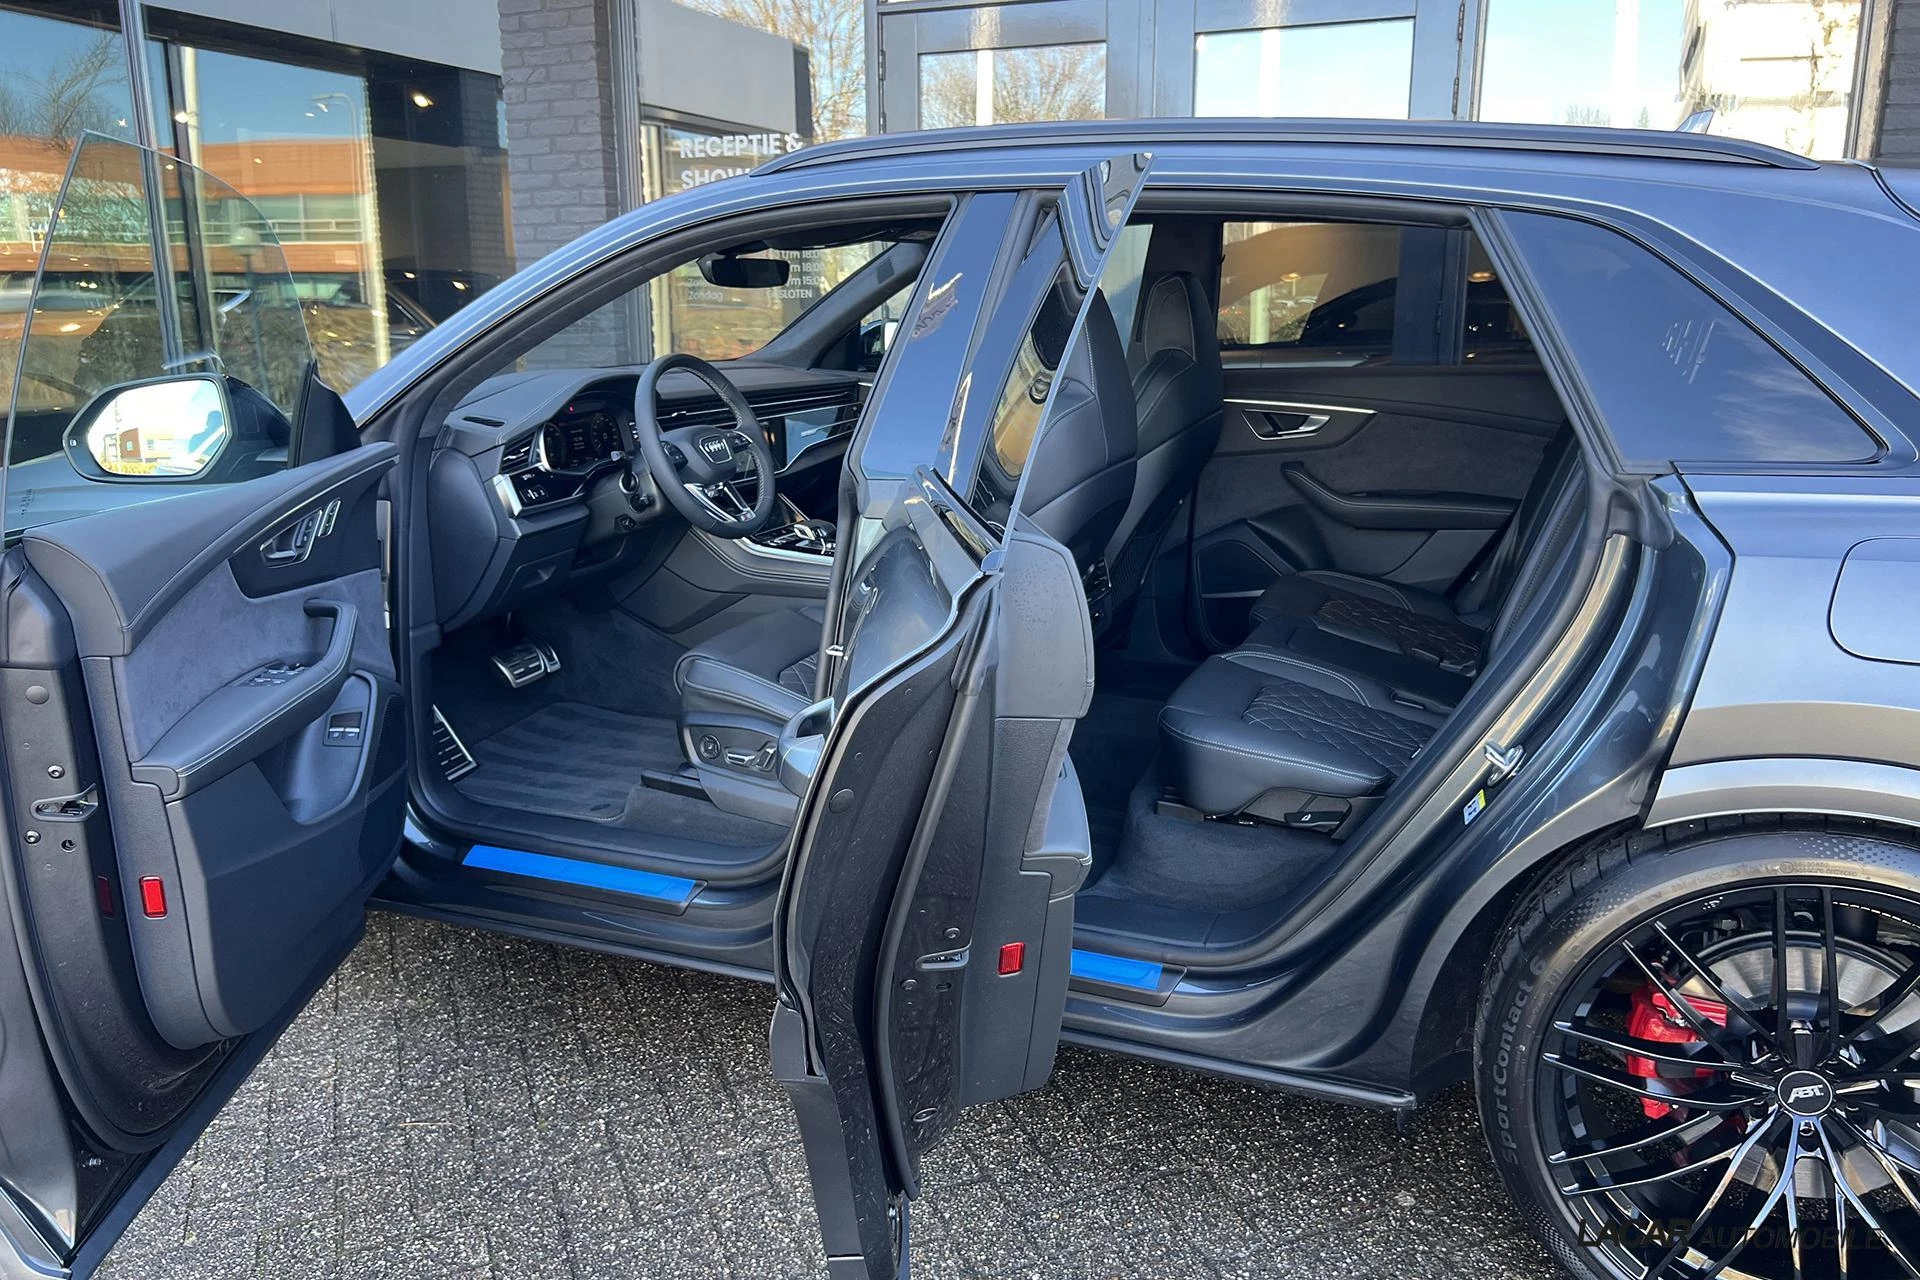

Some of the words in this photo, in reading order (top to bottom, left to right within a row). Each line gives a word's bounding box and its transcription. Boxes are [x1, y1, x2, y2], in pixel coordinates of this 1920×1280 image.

[680, 133, 781, 158] RECEPTIE
[784, 132, 803, 153] &
[1493, 979, 1534, 1166] SportContact
[1529, 955, 1547, 976] 6
[1787, 1084, 1824, 1104] ABT
